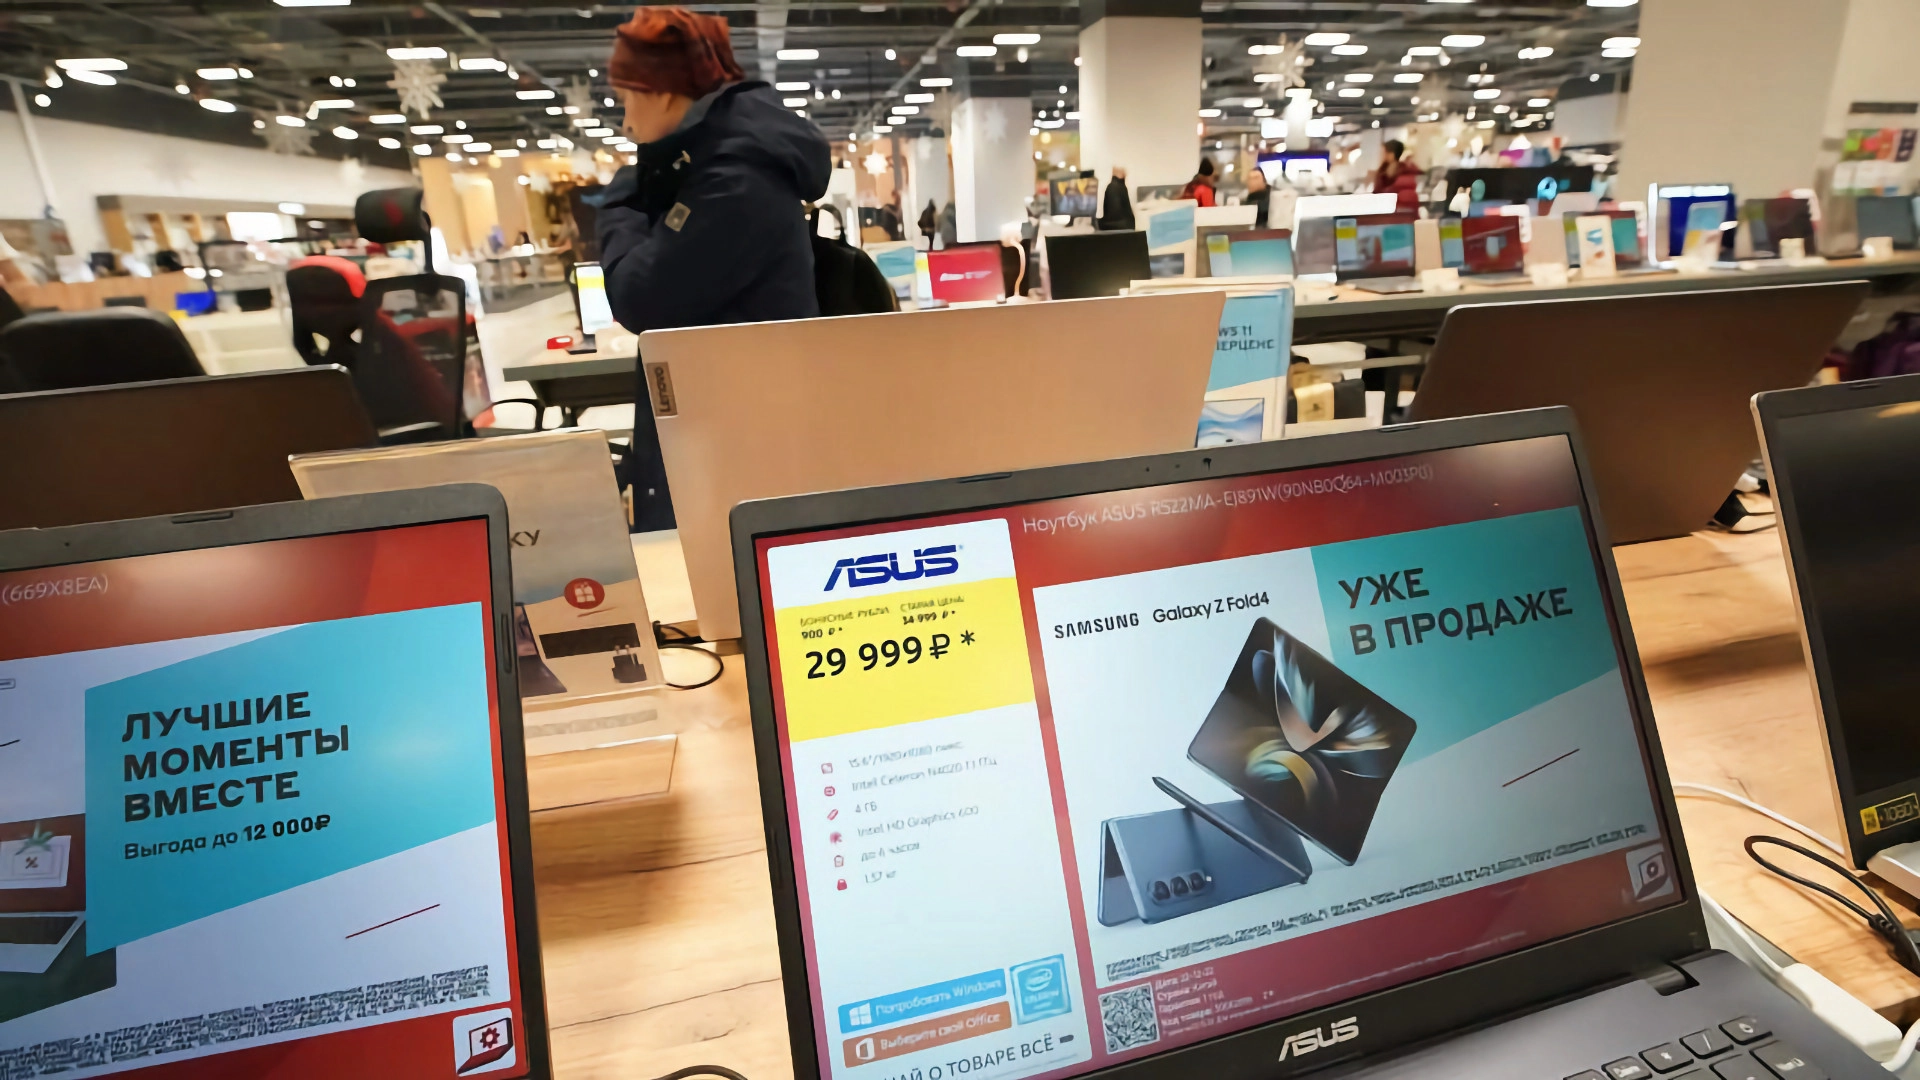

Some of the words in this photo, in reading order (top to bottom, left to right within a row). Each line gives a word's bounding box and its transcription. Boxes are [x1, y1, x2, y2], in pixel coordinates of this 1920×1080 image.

[1023, 510, 1098, 535] Ноутбук
[1102, 503, 1147, 523] ASUS
[2, 573, 109, 606] (669X8EA)
[823, 545, 960, 592] ASUS
[1337, 567, 1430, 609] УЖЕ
[1054, 613, 1139, 639] SAMSUNG
[1152, 602, 1212, 623] Galaxy
[1214, 599, 1225, 614] Z
[1226, 591, 1270, 612] Fold4
[1350, 623, 1377, 655] В
[1384, 587, 1573, 649] ПРОДАЖЕ
[805, 648, 847, 679] 29
[122, 691, 311, 743] ЛУЧШИЕ
[123, 725, 349, 782] МОМЕНТЫ
[124, 770, 300, 823] ВМЕСТЕ
[124, 836, 206, 860] Выгода
[212, 831, 238, 850] до
[243, 824, 266, 842] 12
[929, 1065, 943, 1080] О
[946, 1046, 1017, 1077] ТОВАРЕ
[1020, 1033, 1055, 1058] ВСЁ
[1278, 1016, 1360, 1062] ASUS
